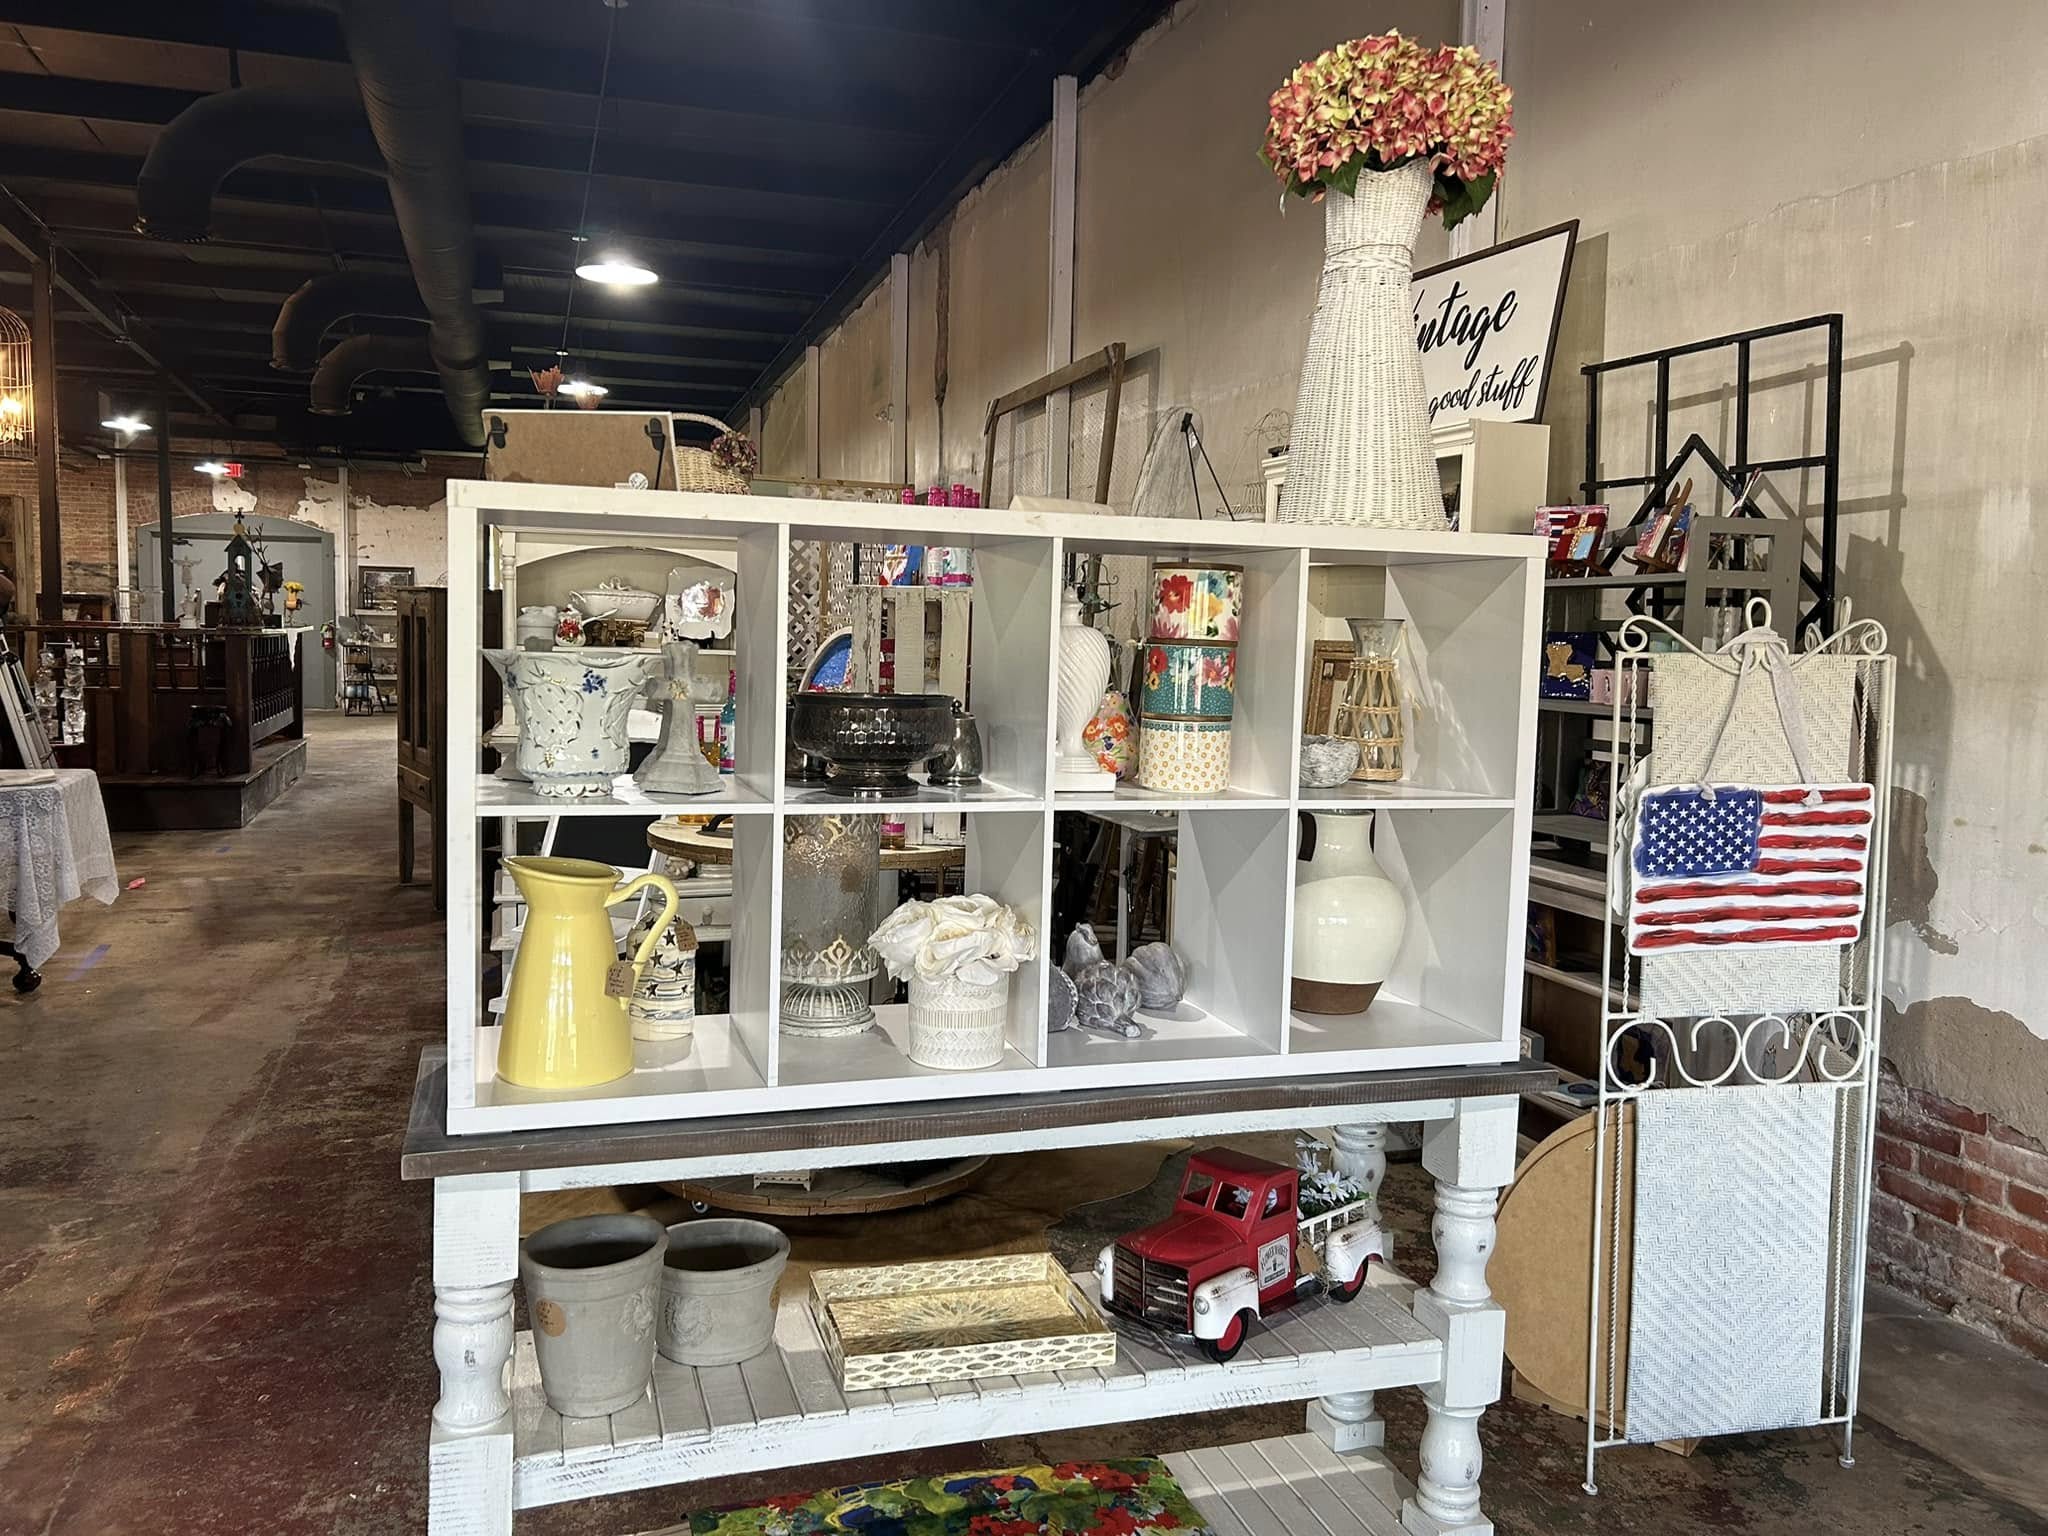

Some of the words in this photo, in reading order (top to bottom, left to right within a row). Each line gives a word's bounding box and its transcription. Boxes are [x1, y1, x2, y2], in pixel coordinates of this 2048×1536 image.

[1412, 280, 1519, 370] ntage
[1428, 368, 1482, 424] good
[1476, 354, 1540, 411] stuff
